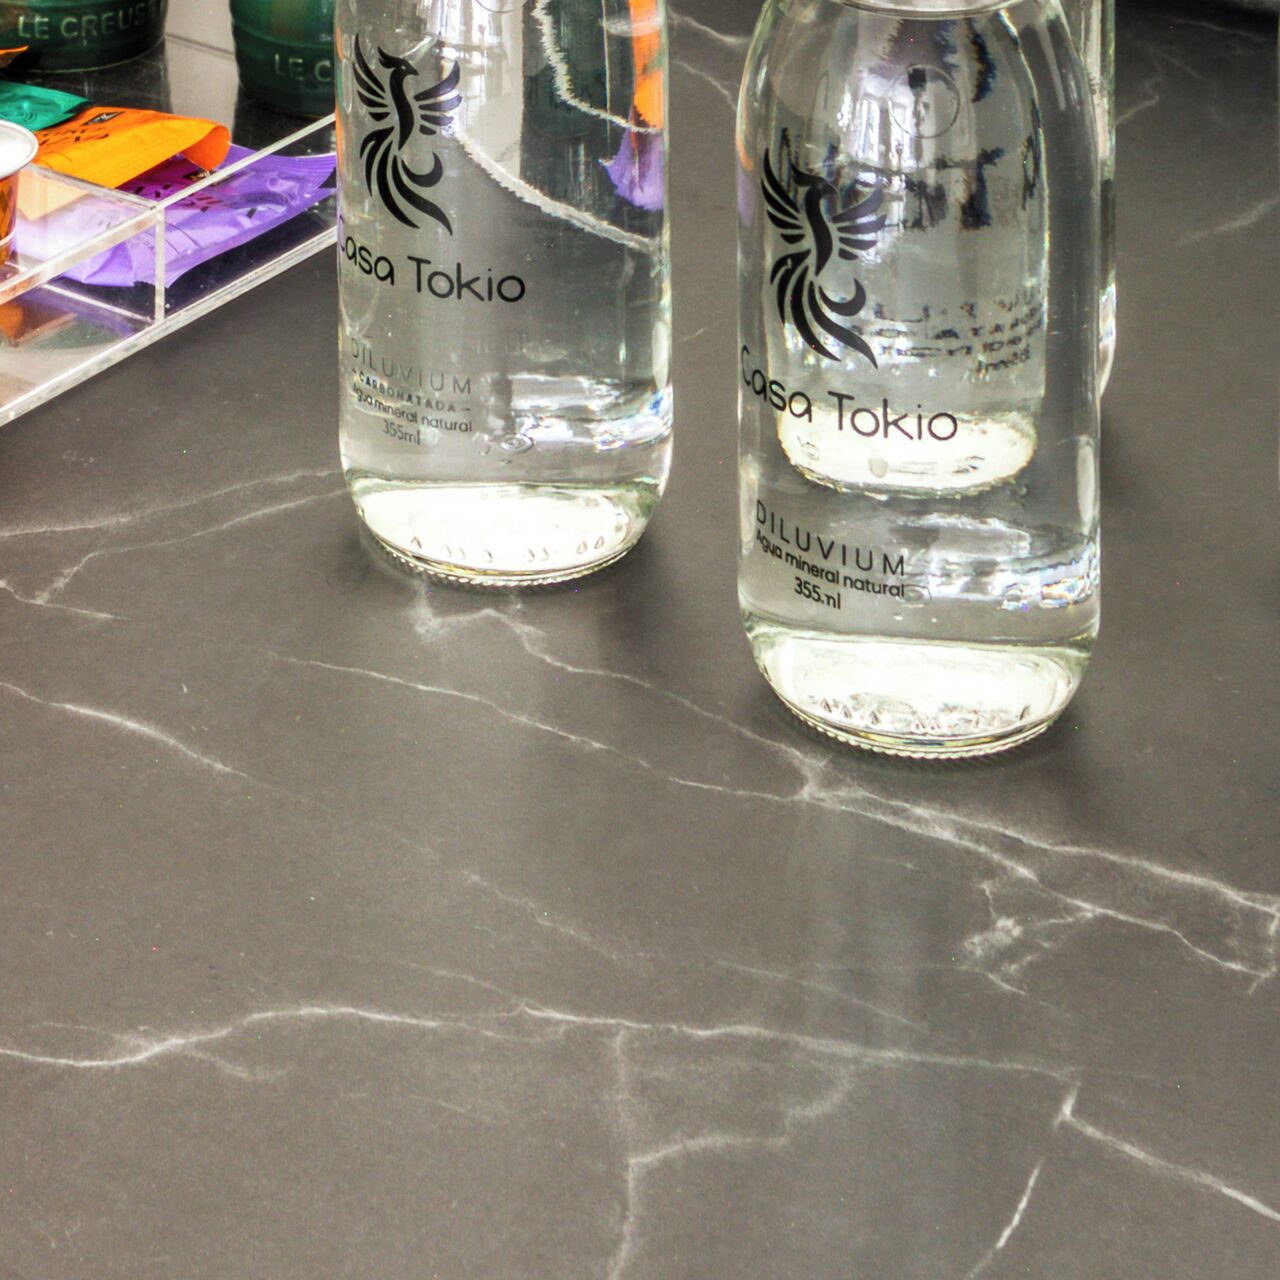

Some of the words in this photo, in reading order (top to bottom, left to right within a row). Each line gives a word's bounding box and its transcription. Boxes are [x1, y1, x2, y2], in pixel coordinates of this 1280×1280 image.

[18, 14, 50, 40] LE
[275, 53, 304, 80] LE
[407, 255, 525, 303] Tokio
[352, 337, 471, 395] DILUVIUM
[374, 399, 418, 424] mineral
[422, 416, 472, 432] natural
[741, 345, 812, 423] Casa
[828, 390, 958, 441] Tokio
[383, 419, 420, 445] 355ml
[756, 499, 905, 576] DILUVIUM
[756, 530, 782, 559] Agua
[785, 552, 839, 585] mineral
[843, 575, 905, 597] natural
